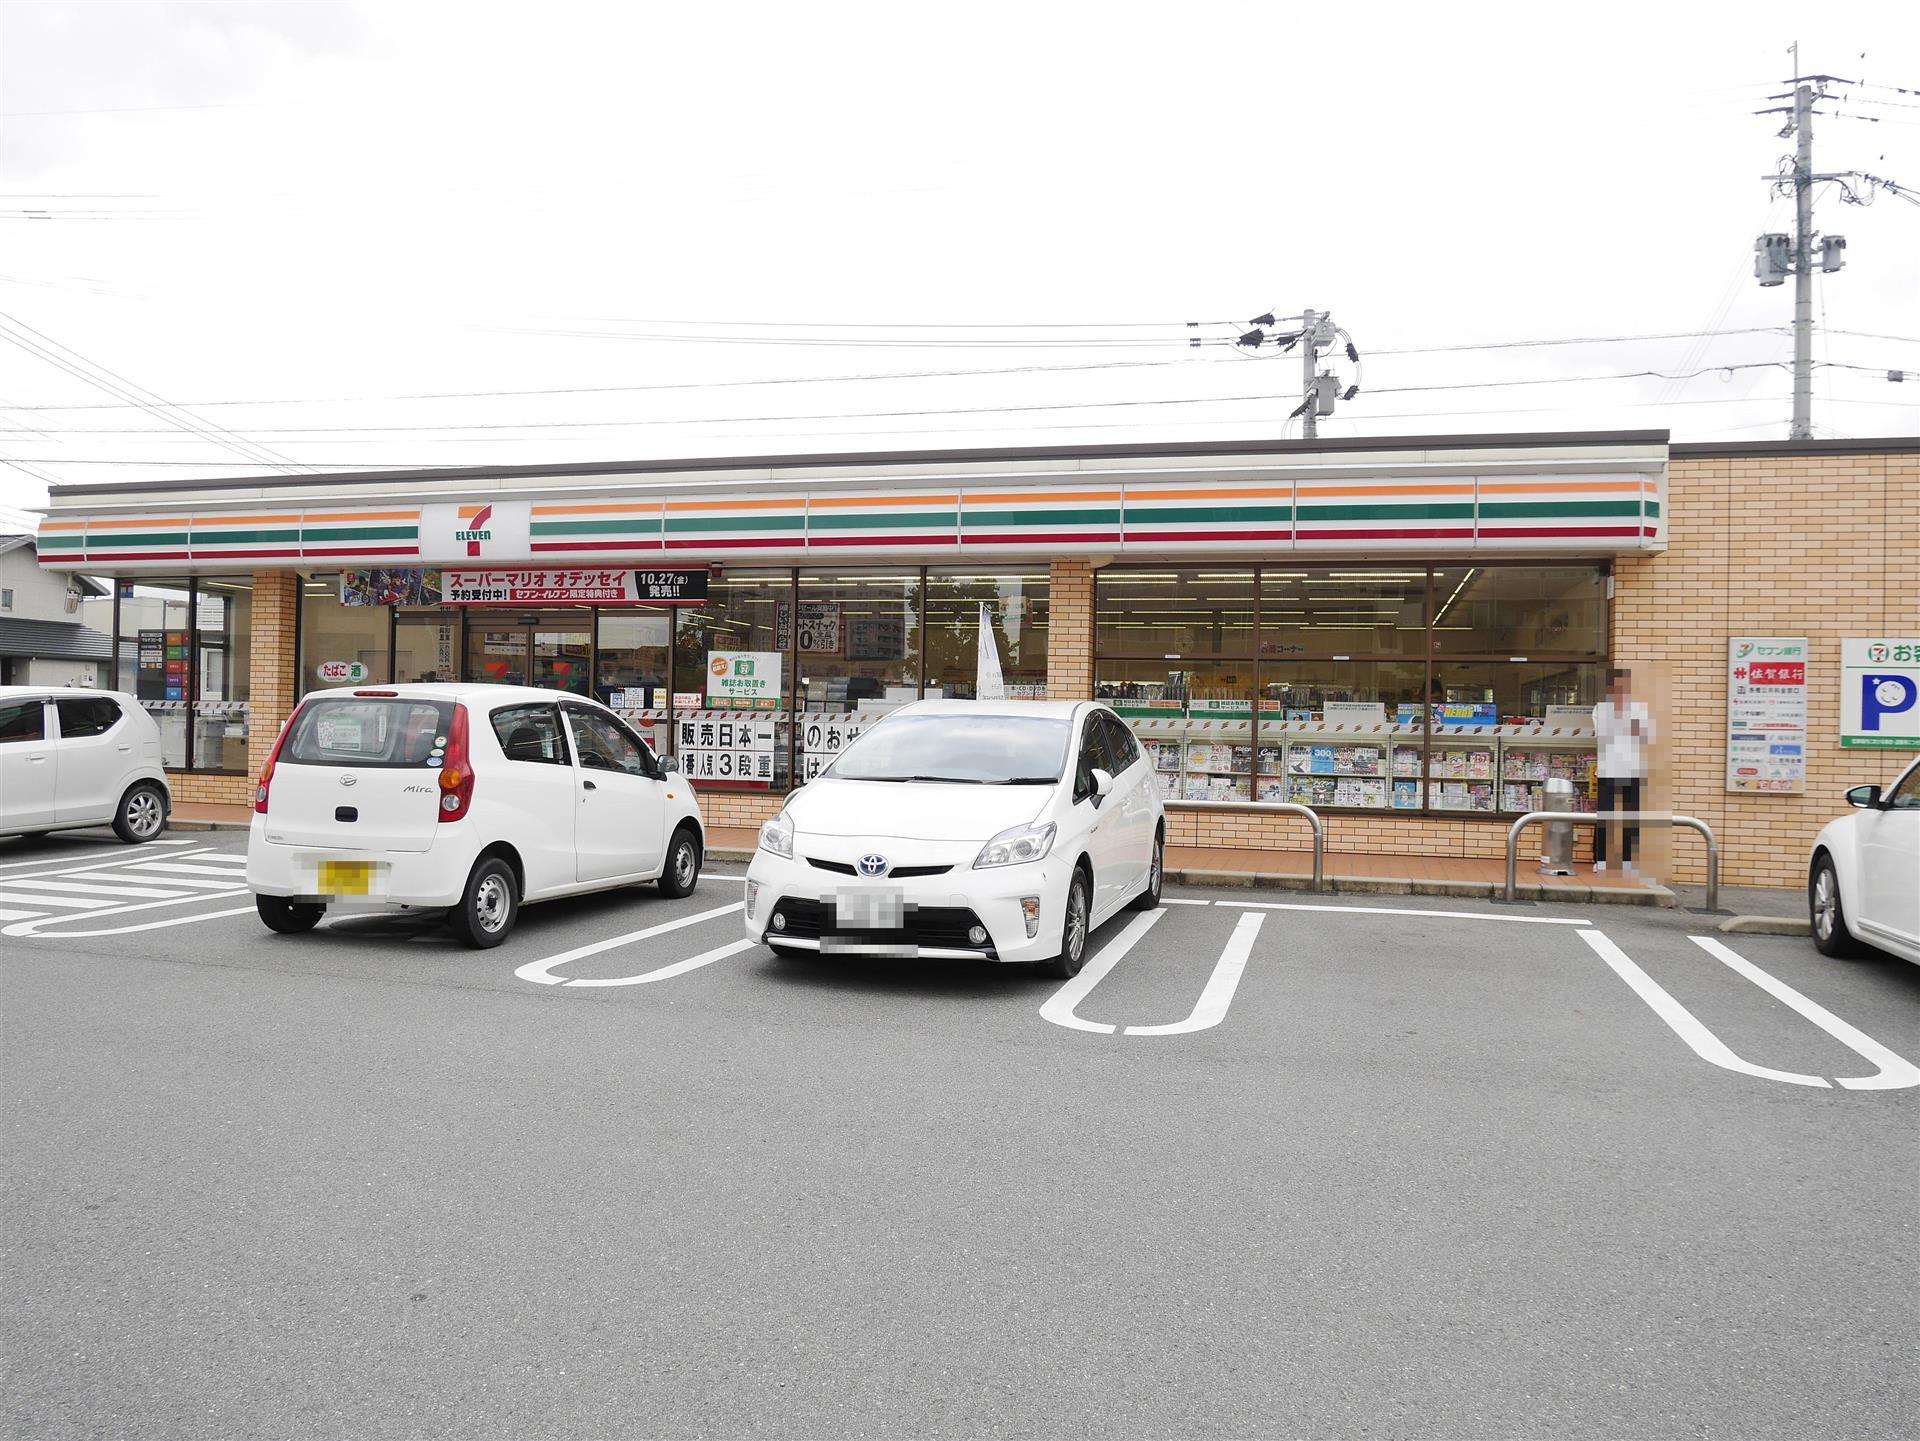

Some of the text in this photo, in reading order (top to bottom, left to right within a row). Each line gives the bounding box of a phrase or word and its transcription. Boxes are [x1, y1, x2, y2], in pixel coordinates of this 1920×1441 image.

[456, 530, 491, 541] ELEVEN
[450, 571, 627, 588] スーパーマリオ オデッセイ
[450, 589, 507, 600] 予約受付中!
[323, 664, 361, 677] たばこ 酒
[1751, 669, 1803, 680] 佐賀銀行
[729, 688, 758, 696] サービス
[1862, 674, 1917, 731] P
[681, 723, 772, 747] 販売日本一
[681, 753, 771, 778] 1番人気3段重
[403, 785, 433, 793] Mira
